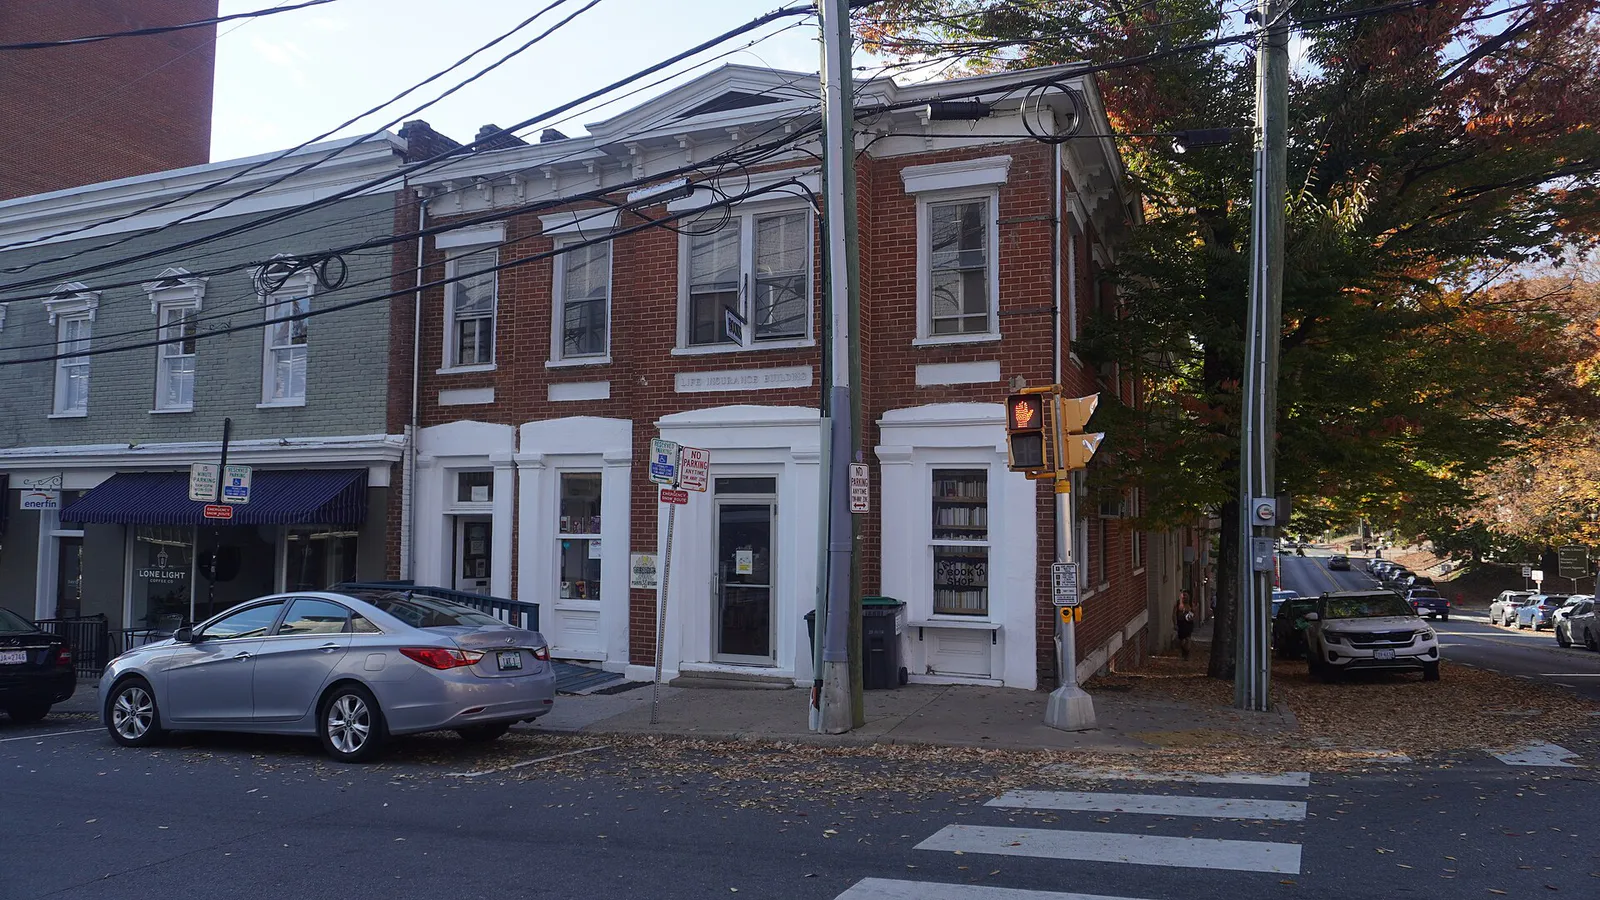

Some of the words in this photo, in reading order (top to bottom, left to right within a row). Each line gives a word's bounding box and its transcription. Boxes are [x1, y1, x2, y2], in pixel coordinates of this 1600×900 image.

[681, 378, 701, 387] LIFE
[707, 375, 759, 386] INSURANCE
[764, 372, 807, 383] BUILDING
[691, 450, 702, 460] NO
[683, 459, 708, 470] PARKING
[855, 466, 864, 476] NO
[851, 477, 868, 487] PARKING
[139, 570, 160, 578] LONE
[161, 571, 186, 579] LIGHT
[947, 568, 974, 577] BOOK
[947, 578, 974, 586] SHOP
